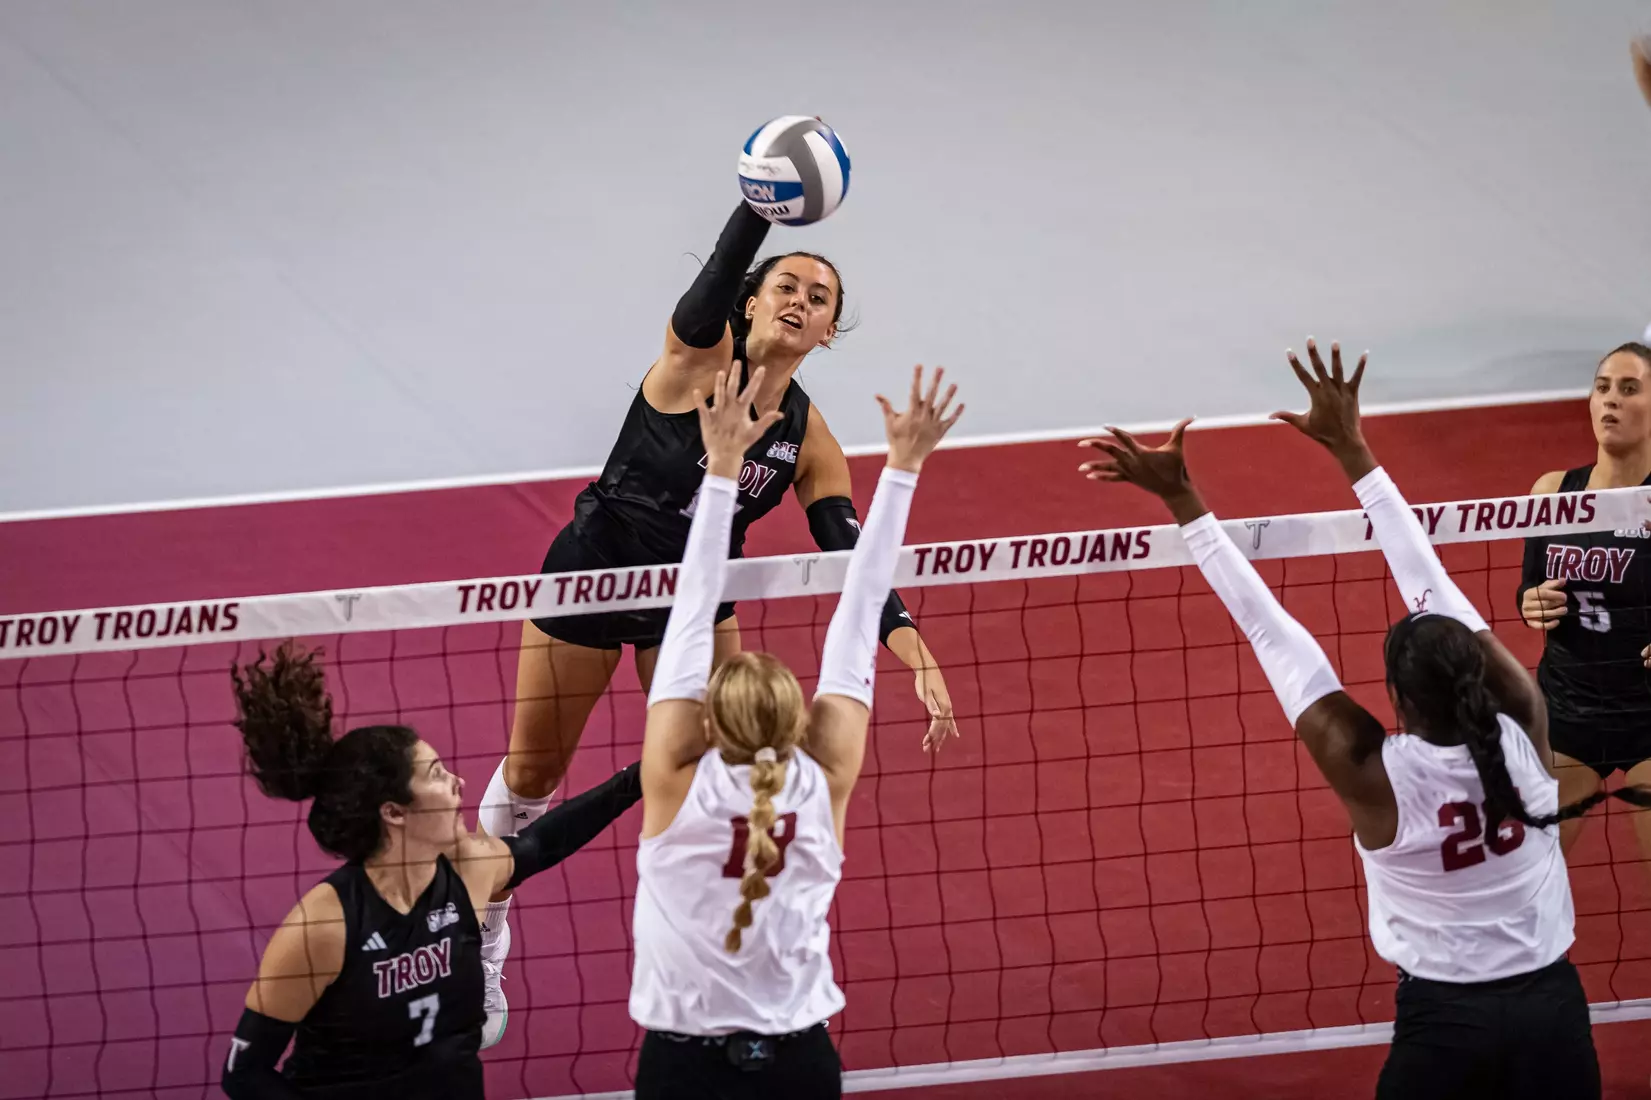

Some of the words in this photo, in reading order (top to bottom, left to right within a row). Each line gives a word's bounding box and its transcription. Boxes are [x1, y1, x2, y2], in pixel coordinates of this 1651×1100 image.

[697, 452, 777, 498] OY
[1363, 506, 1445, 541] TY
[1457, 493, 1596, 533] TROJANS
[915, 543, 997, 577] TROY
[1010, 530, 1152, 569] TROJANS
[1545, 543, 1635, 584] TROY
[458, 580, 542, 613] TROY
[555, 566, 681, 606] TROJAN
[1571, 591, 1612, 633] 5
[0, 615, 81, 648] TROY
[94, 602, 240, 640] TROJANS
[373, 937, 452, 999] TROY
[408, 993, 441, 1047] 7
